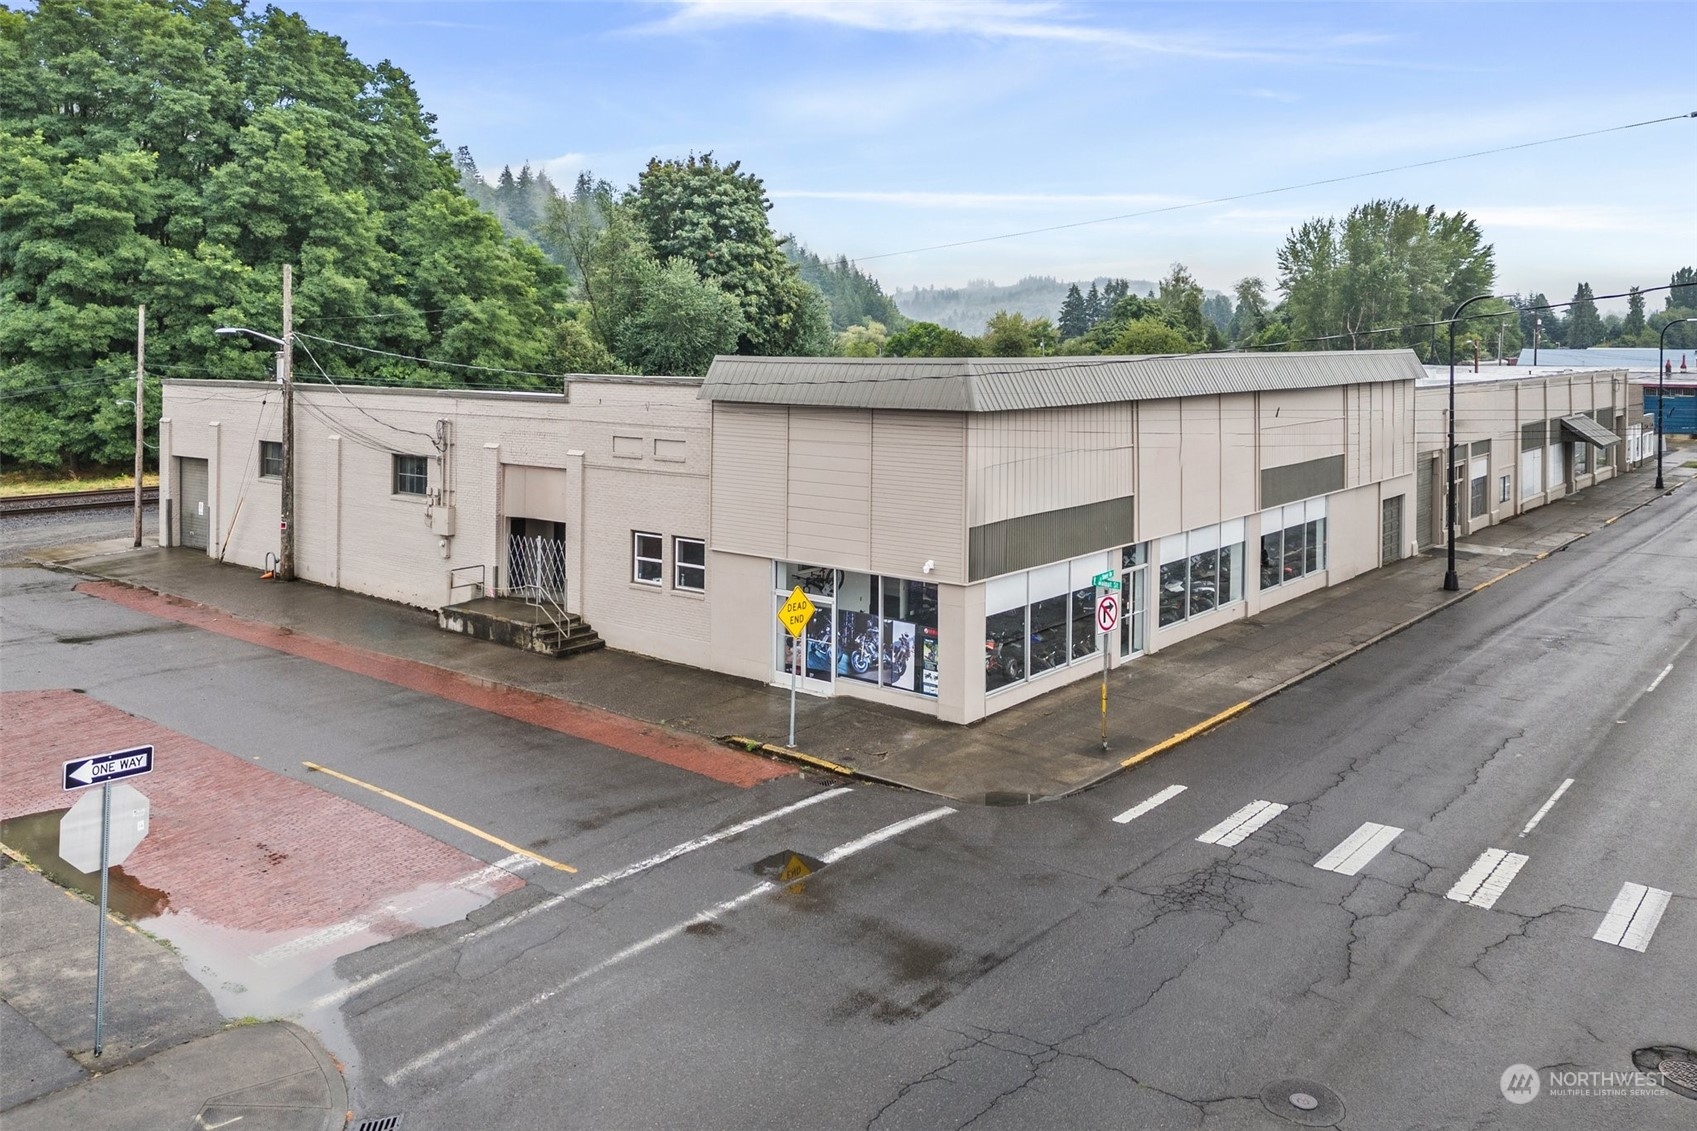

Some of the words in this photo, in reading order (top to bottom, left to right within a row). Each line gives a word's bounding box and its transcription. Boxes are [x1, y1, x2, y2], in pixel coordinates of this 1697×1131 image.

[787, 601, 807, 612] DEAD
[790, 614, 805, 625] END
[92, 762, 115, 776] ONE
[120, 756, 144, 770] WAY
